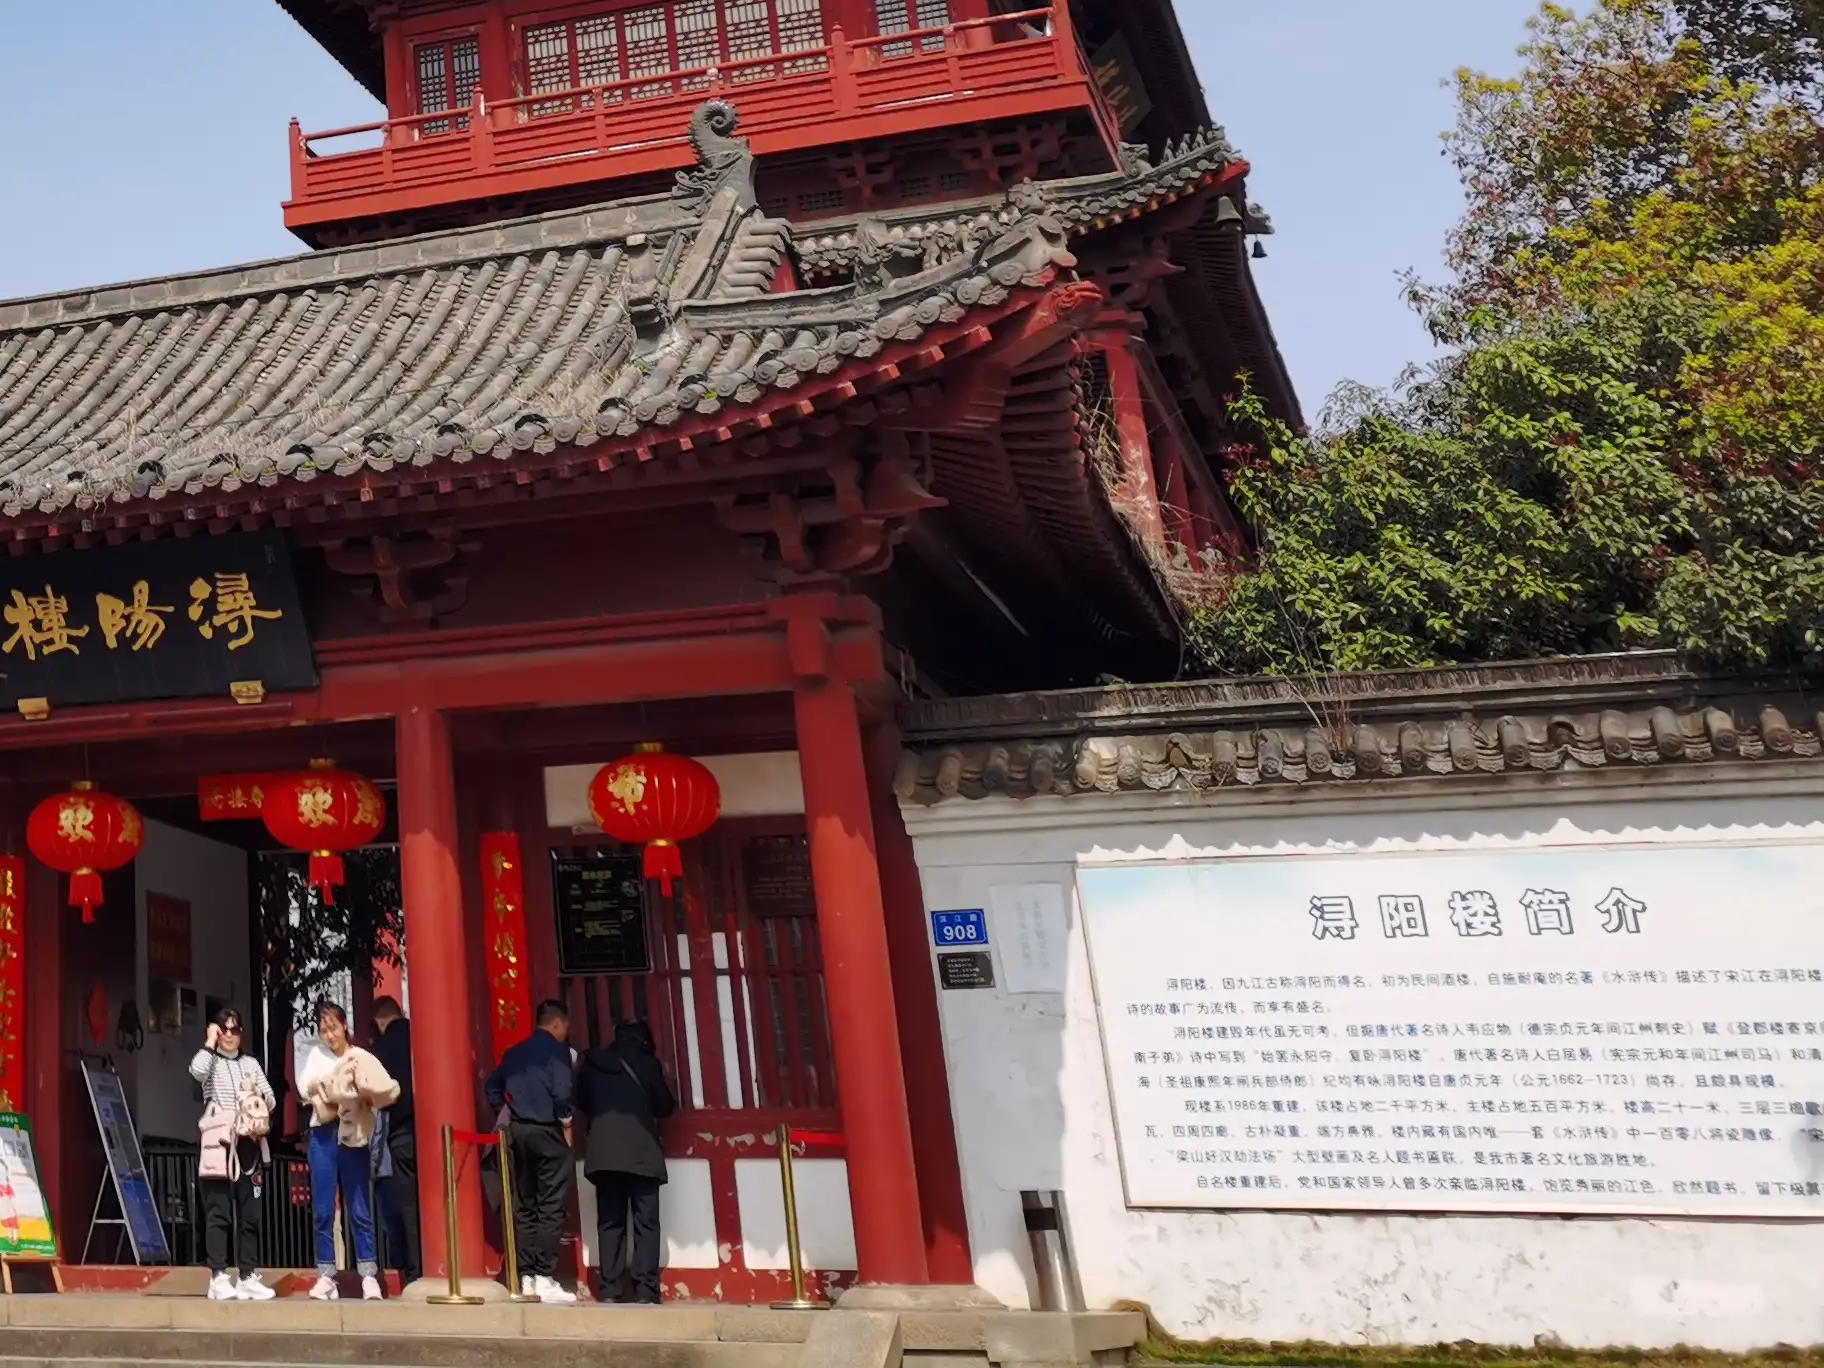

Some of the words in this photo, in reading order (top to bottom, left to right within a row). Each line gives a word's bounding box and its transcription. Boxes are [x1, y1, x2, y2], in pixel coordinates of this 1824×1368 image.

[1308, 886, 1649, 940] 浔阳楼简介
[943, 924, 977, 941] 908
